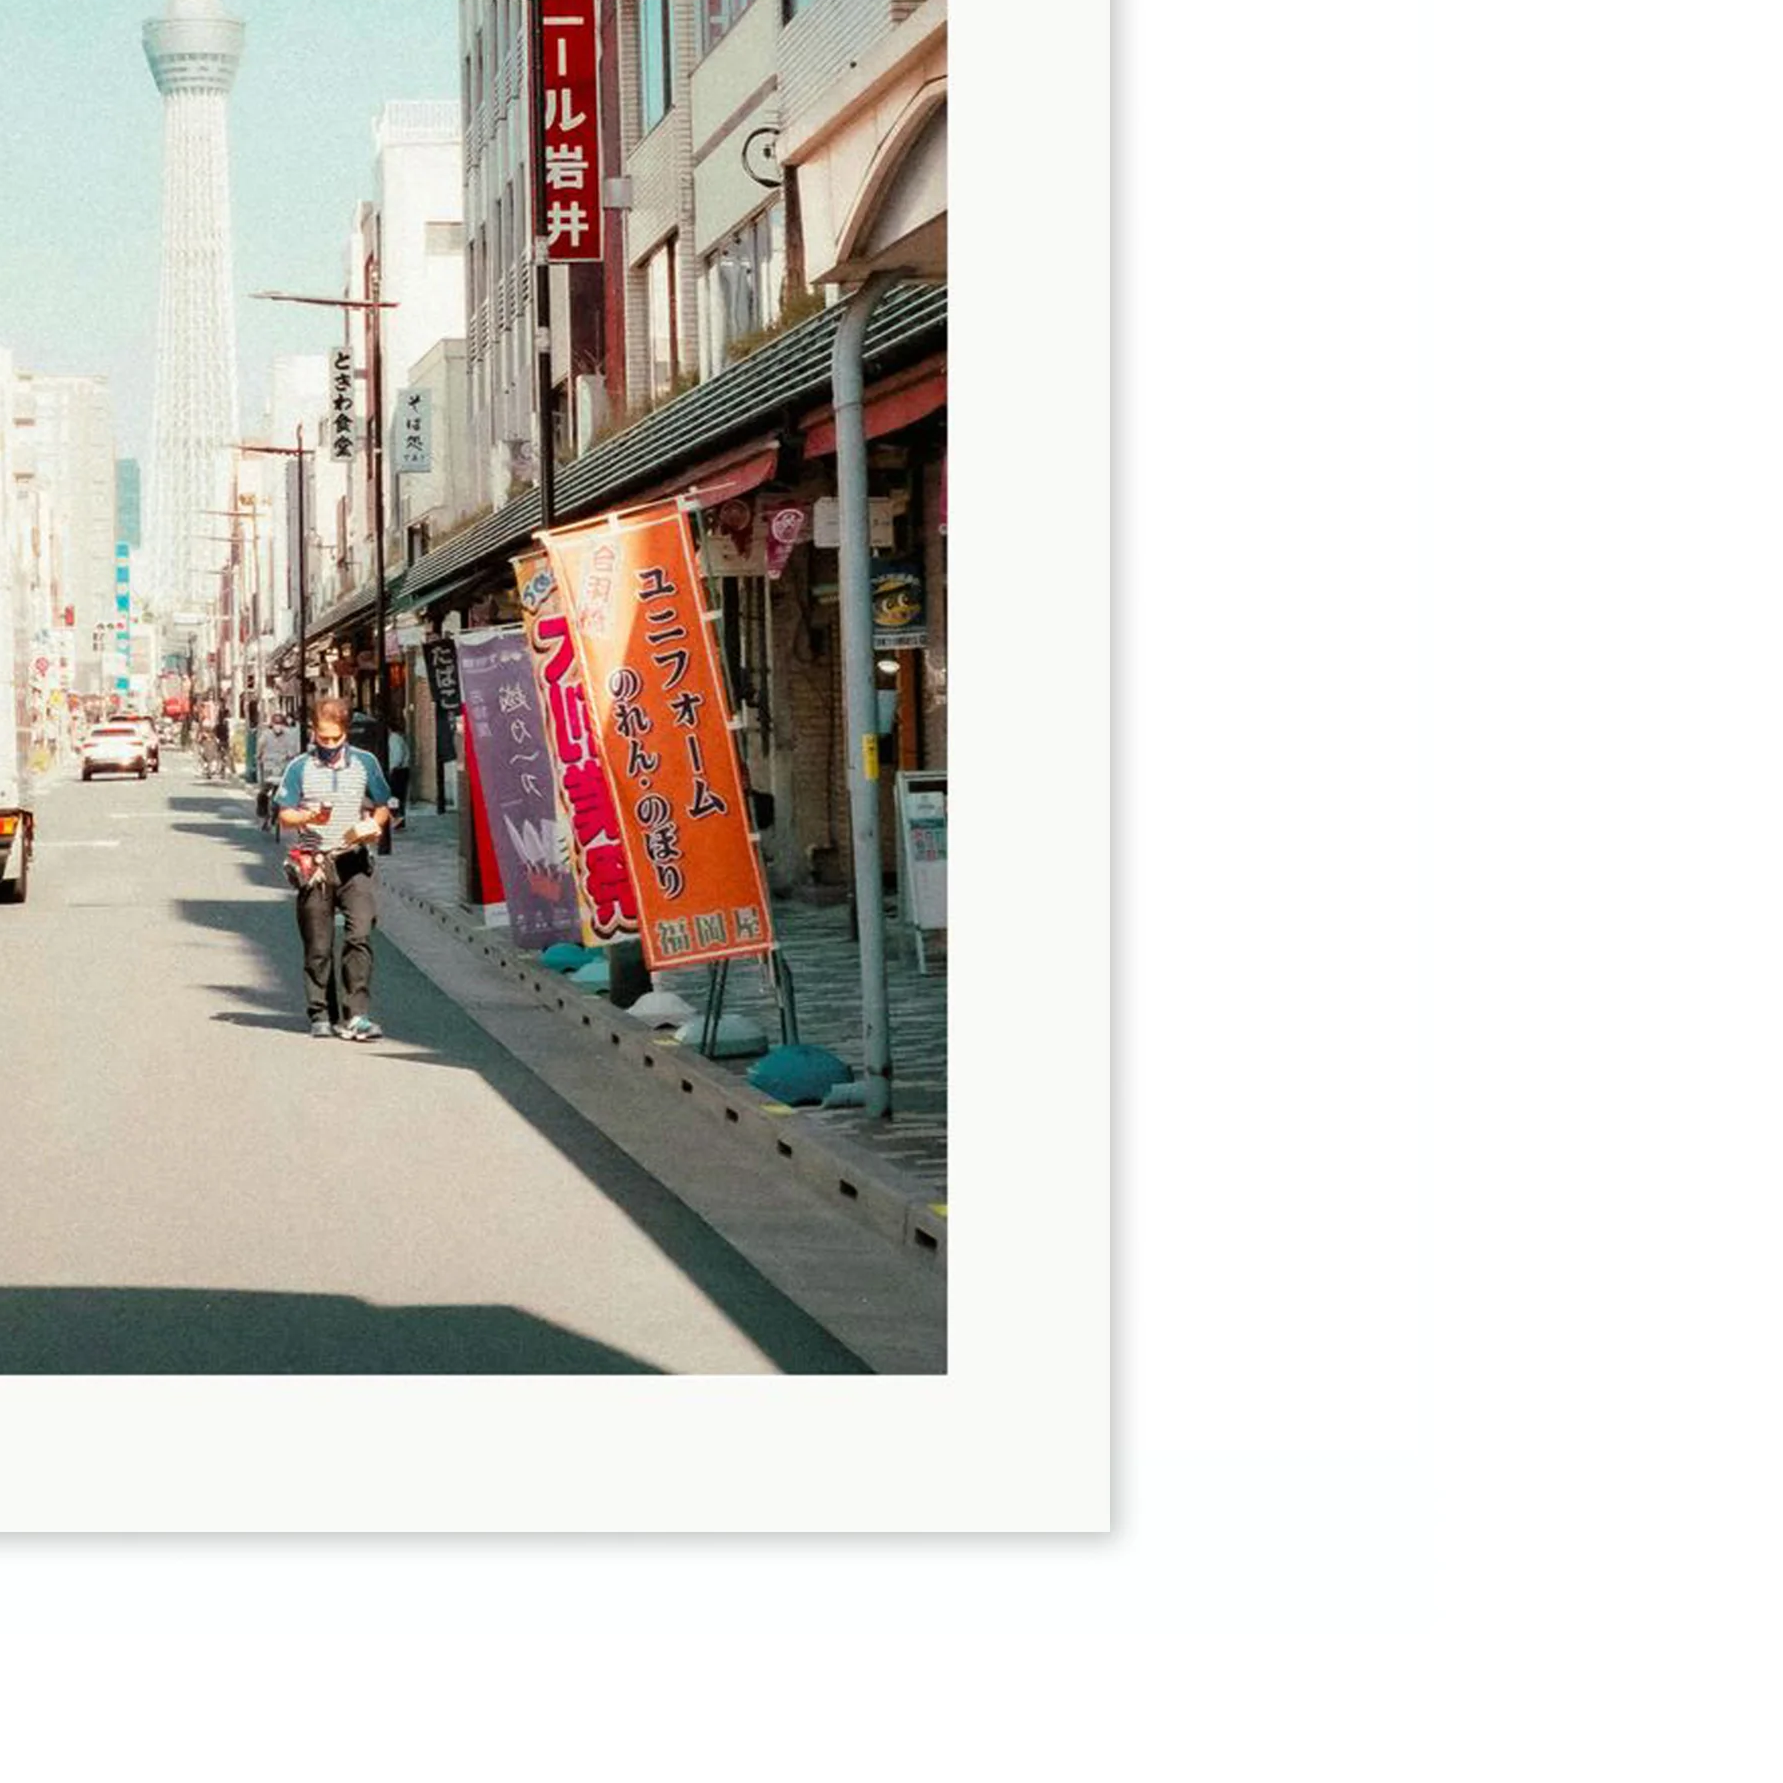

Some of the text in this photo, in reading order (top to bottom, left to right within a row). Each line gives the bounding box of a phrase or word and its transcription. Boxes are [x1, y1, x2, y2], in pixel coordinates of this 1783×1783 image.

[637, 566, 728, 819] ユニフォーム
[656, 905, 762, 956] 福岡屋
